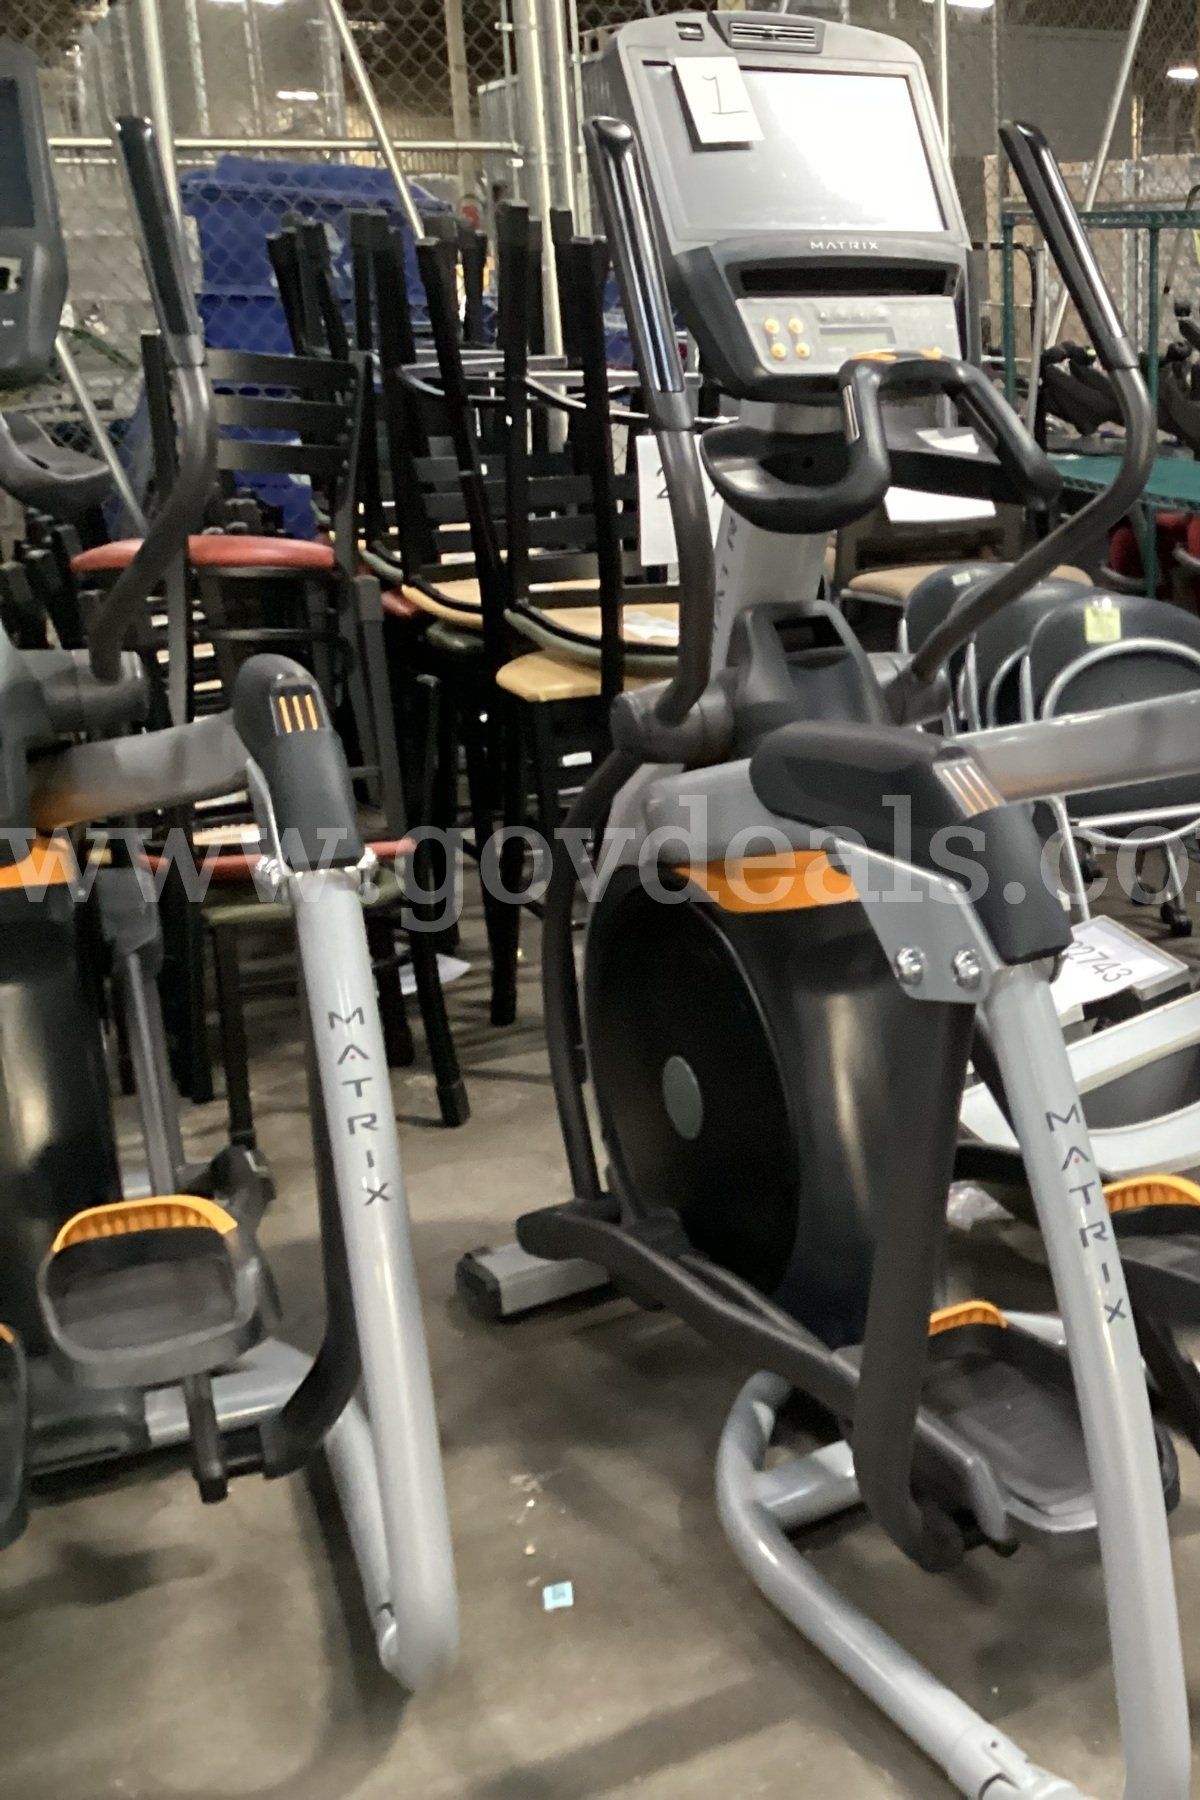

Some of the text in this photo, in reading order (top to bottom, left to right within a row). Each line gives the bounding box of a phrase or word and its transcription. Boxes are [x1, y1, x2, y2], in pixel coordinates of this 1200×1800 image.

[702, 75, 749, 115] 1
[810, 240, 879, 250] MATRIX
[328, 1006, 391, 1206] MATRIX
[1045, 1103, 1127, 1324] MATRIX
